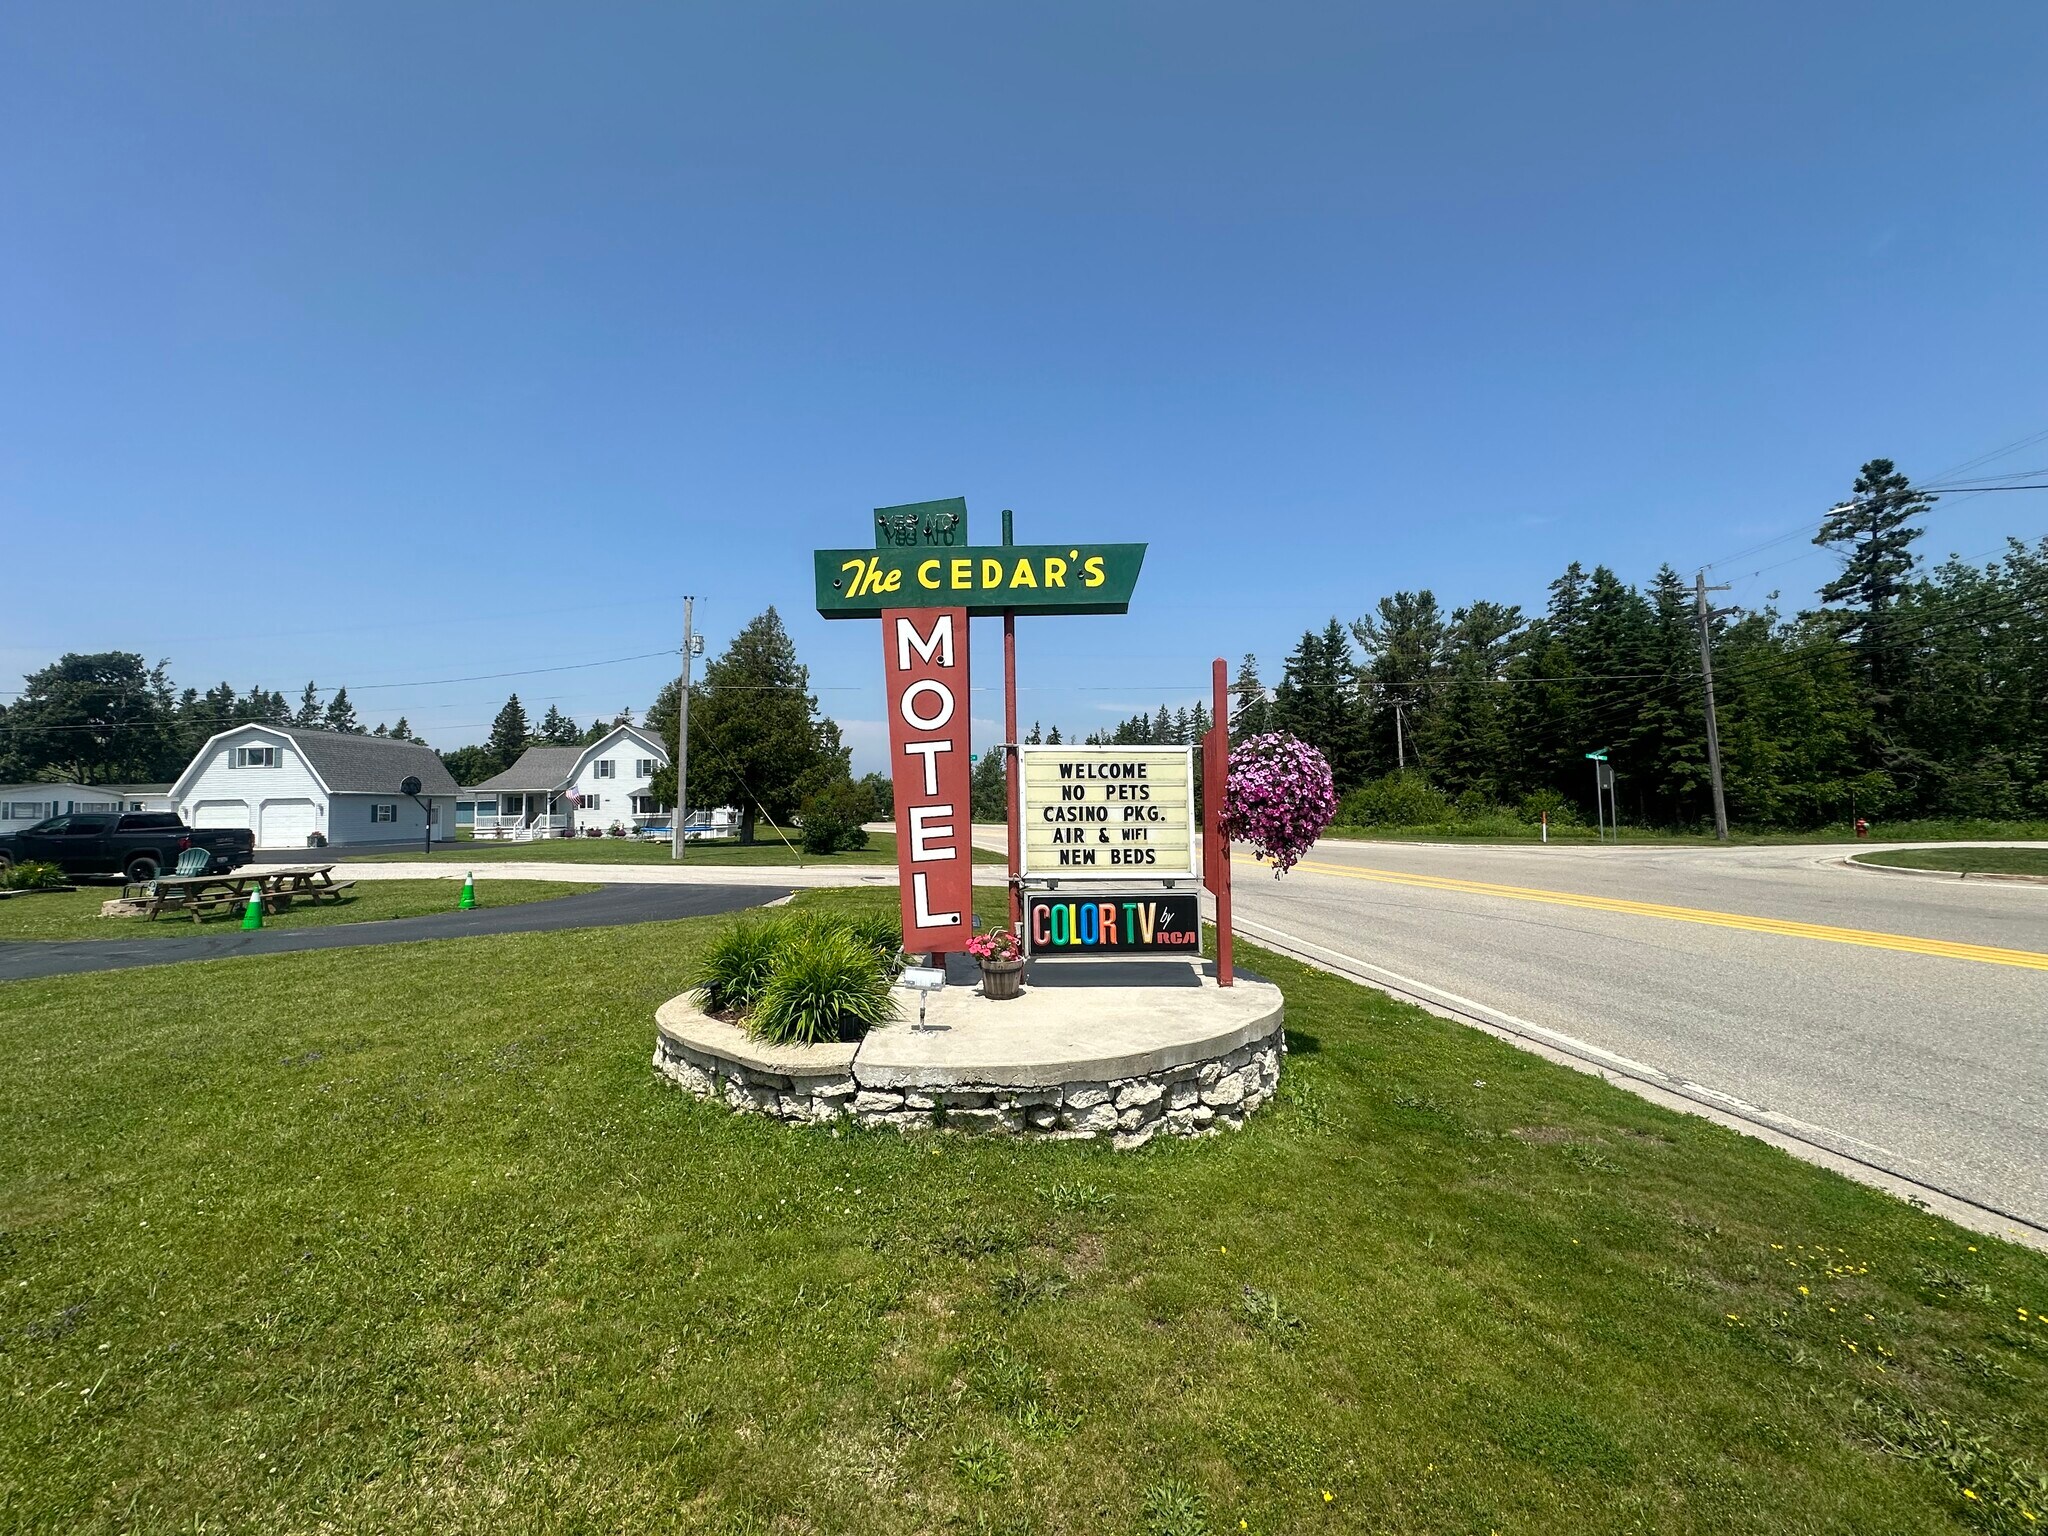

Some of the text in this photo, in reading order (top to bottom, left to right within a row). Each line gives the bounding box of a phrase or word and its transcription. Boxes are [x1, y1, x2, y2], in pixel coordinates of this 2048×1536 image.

[842, 549, 1106, 599] The CEDAR'S
[896, 614, 962, 929] MOTEL
[1059, 763, 1147, 779] WELCOME
[1062, 785, 1150, 801] NO PETS
[1043, 806, 1166, 822] CASINO PKG.
[1053, 828, 1147, 844] AIR & WIFI
[1059, 849, 1156, 865] NEW BEDS
[1033, 902, 1174, 946] COLOR TV by
[1157, 931, 1196, 944] RCA
